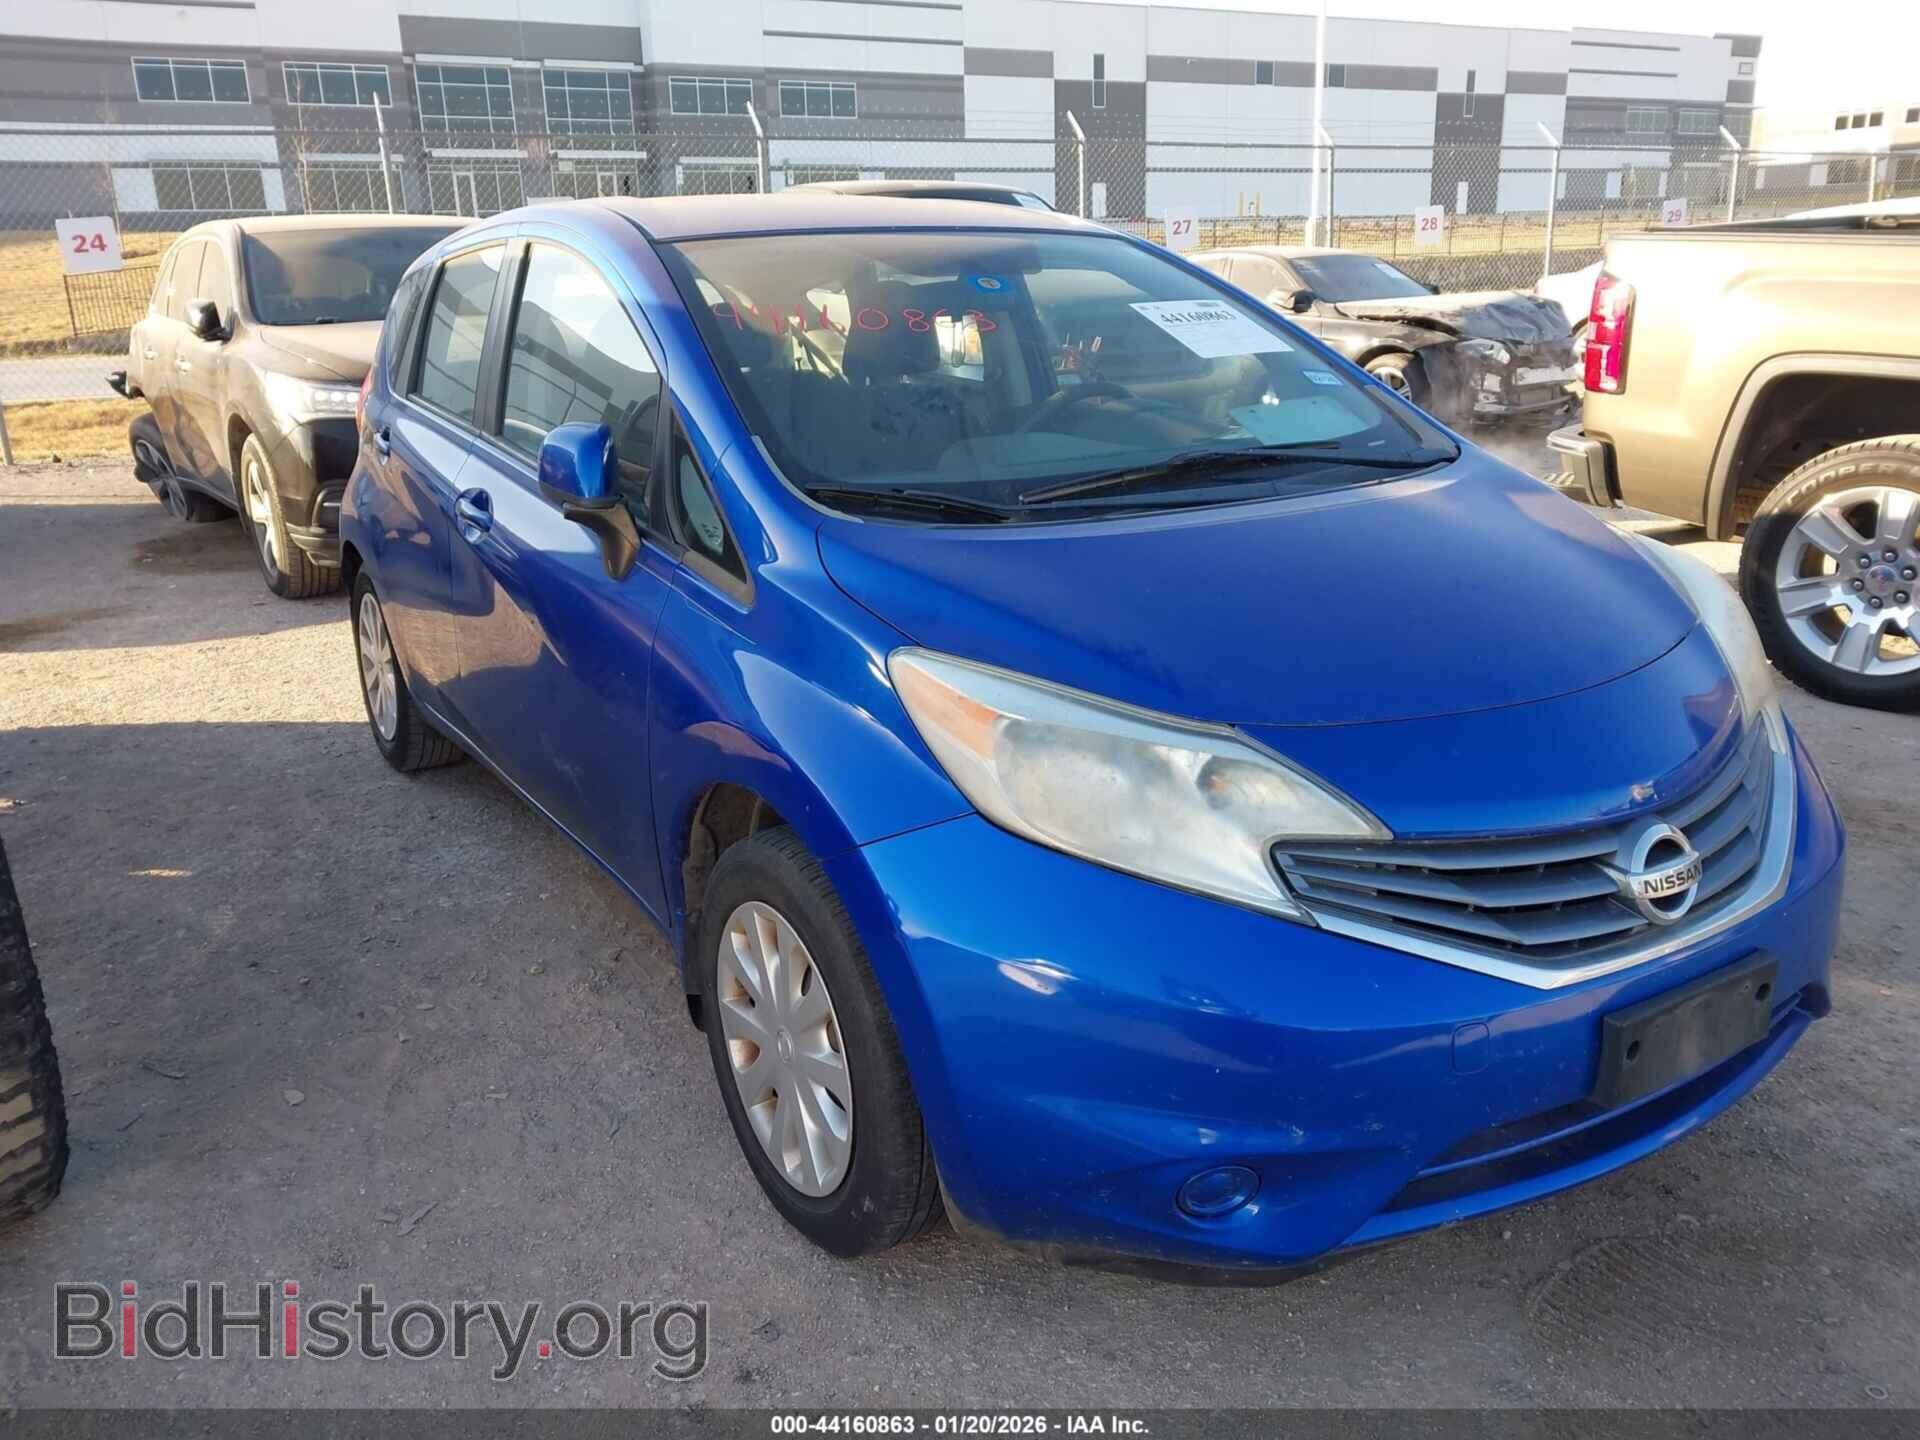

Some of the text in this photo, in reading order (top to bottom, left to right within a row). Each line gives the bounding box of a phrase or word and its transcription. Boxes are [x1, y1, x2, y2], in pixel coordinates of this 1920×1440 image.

[1172, 219, 1191, 235] 27
[1422, 217, 1438, 231] 28
[72, 233, 107, 253] 24
[1160, 310, 1237, 323] 44160863
[1644, 863, 1701, 894] NISSAN
